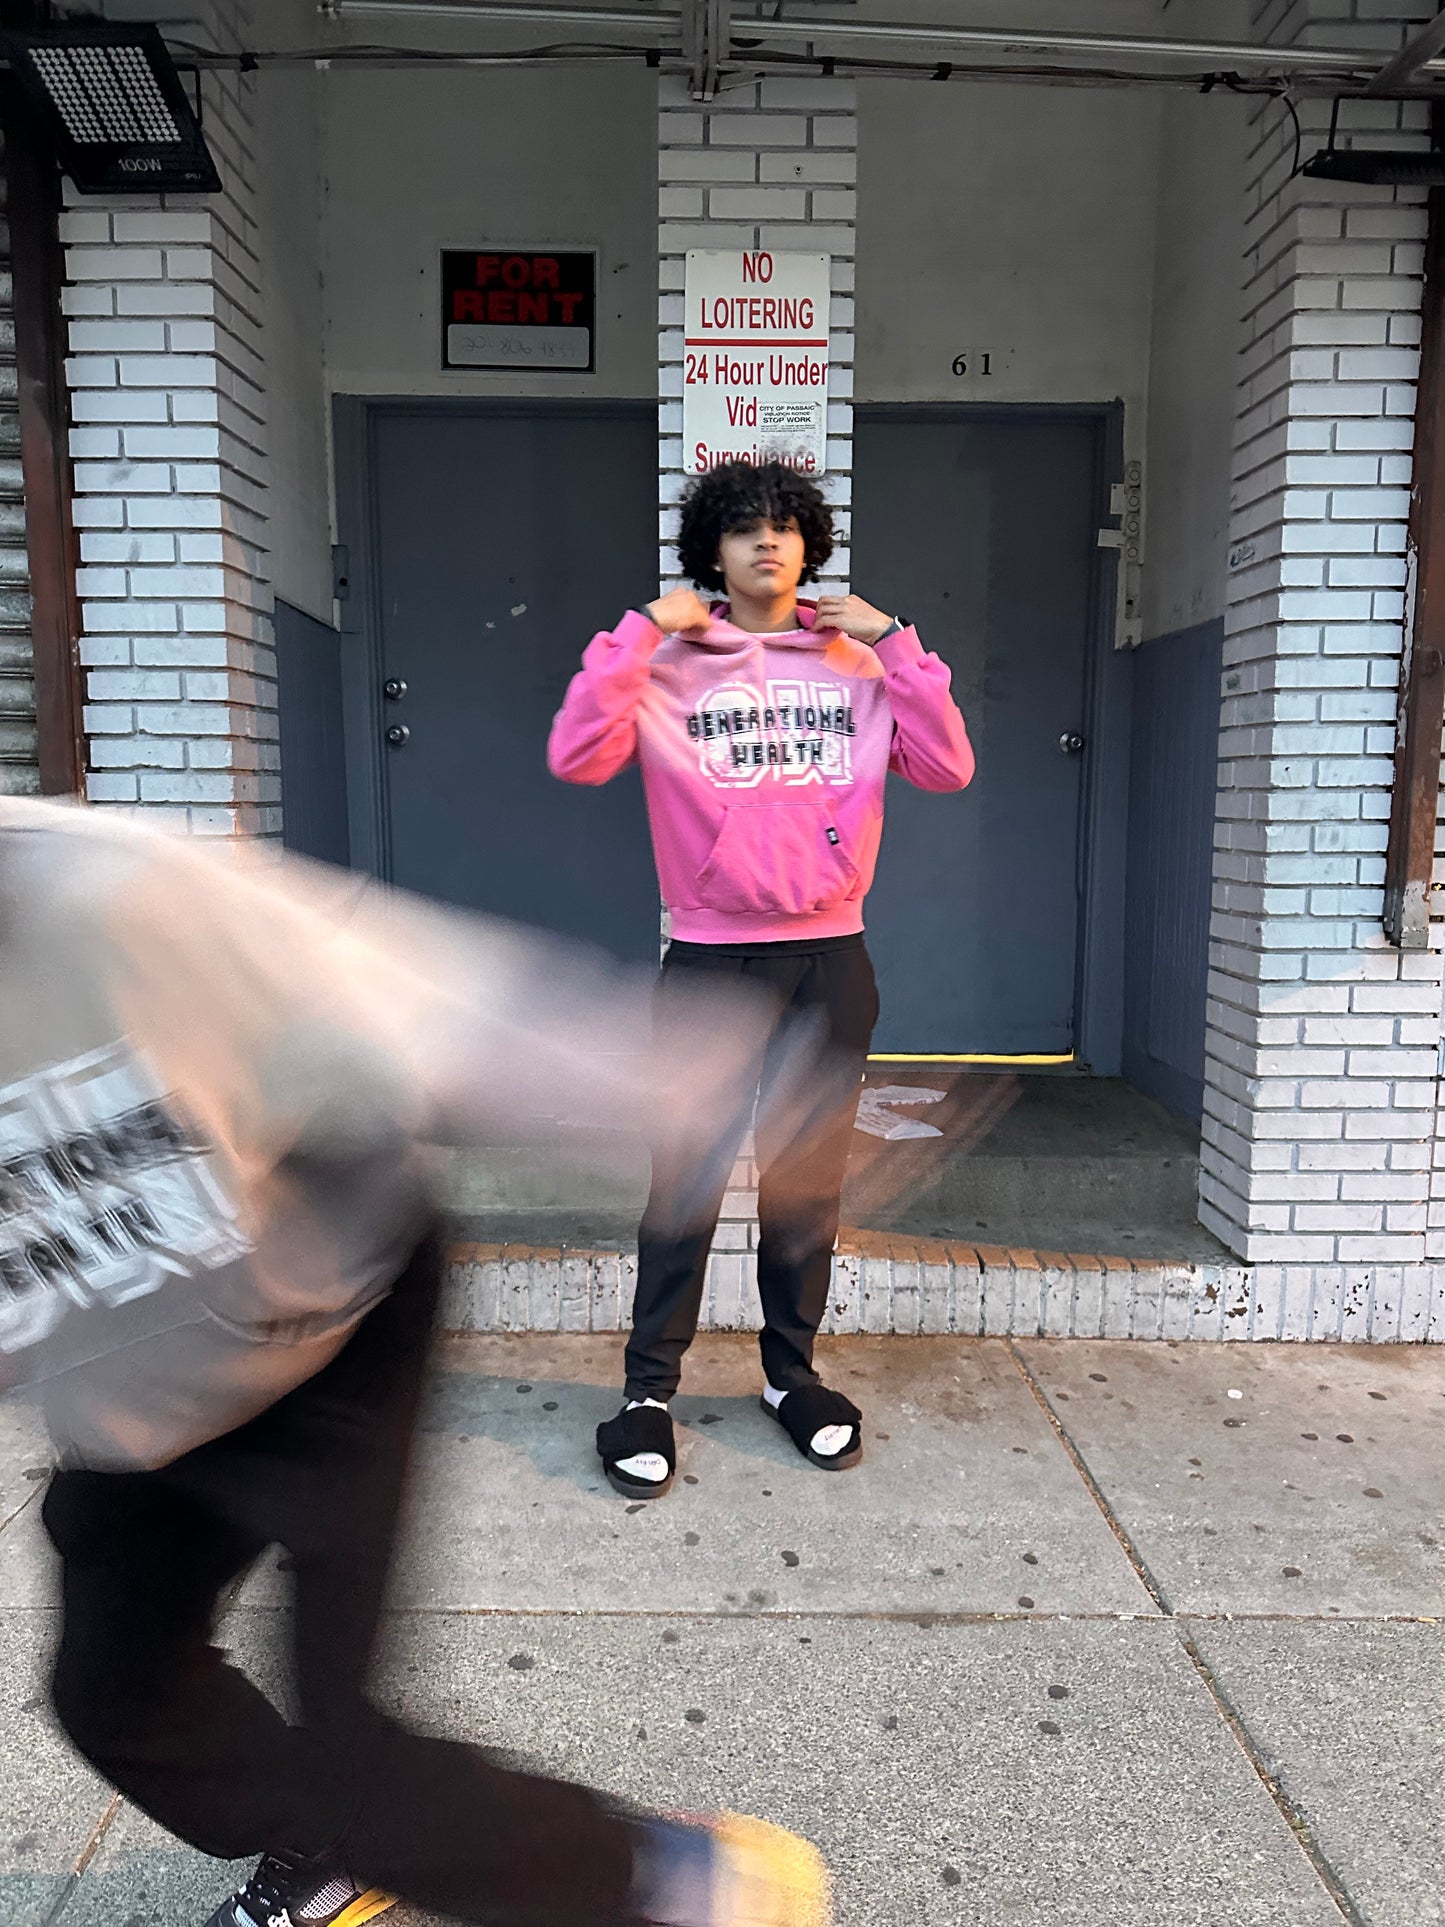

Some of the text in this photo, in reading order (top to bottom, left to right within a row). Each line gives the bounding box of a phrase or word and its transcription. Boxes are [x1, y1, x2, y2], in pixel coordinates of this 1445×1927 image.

[118, 158, 162, 172] 100W
[475, 256, 560, 288] FOR
[743, 252, 773, 283] NO
[453, 289, 584, 324] RENT
[701, 297, 814, 329] LOITERING
[686, 354, 828, 386] 24 Hour Under
[686, 705, 857, 742] GENERATIONAL
